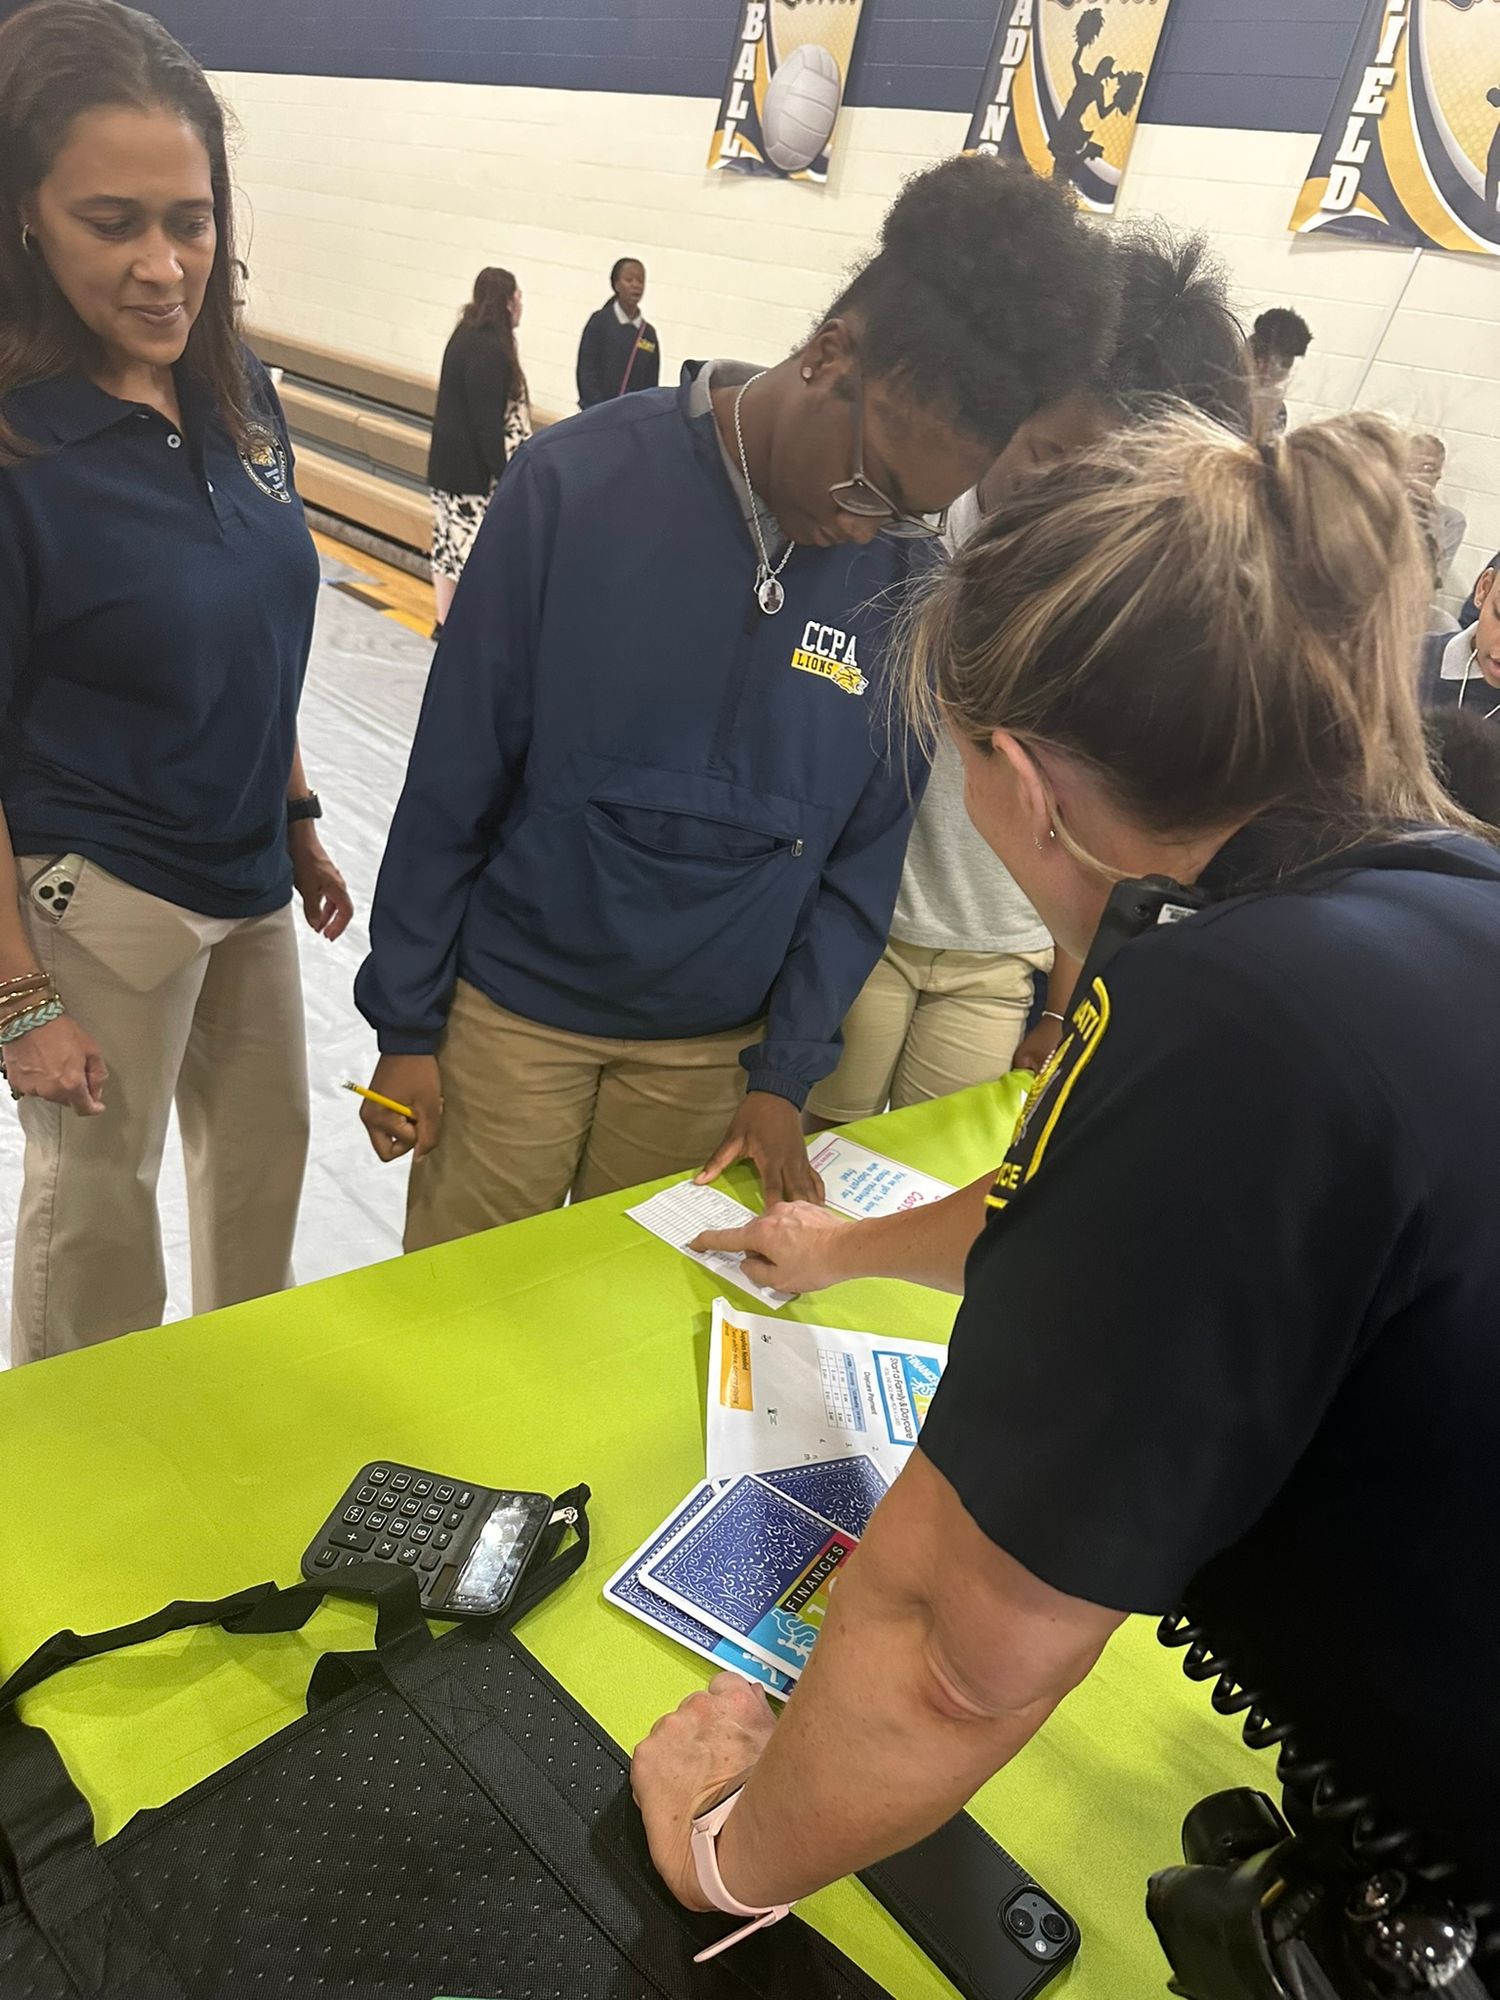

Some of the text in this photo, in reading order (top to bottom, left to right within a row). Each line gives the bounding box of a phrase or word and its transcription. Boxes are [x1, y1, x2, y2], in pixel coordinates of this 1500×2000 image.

[1319, 0, 1408, 210] IELD
[801, 621, 857, 666] CCPA
[796, 653, 833, 675] LIONS
[864, 1371, 878, 1415] Daycare Payment
[895, 1379, 906, 1401] Family
[900, 1408, 914, 1439] Daycare
[375, 1471, 385, 1479] 0
[418, 1483, 428, 1491] 4
[384, 1496, 395, 1504] 2
[406, 1502, 416, 1510] 5
[371, 1515, 382, 1523] 3
[428, 1508, 438, 1516] 8
[416, 1528, 427, 1536] 9
[786, 1546, 844, 1611] FINANCES
